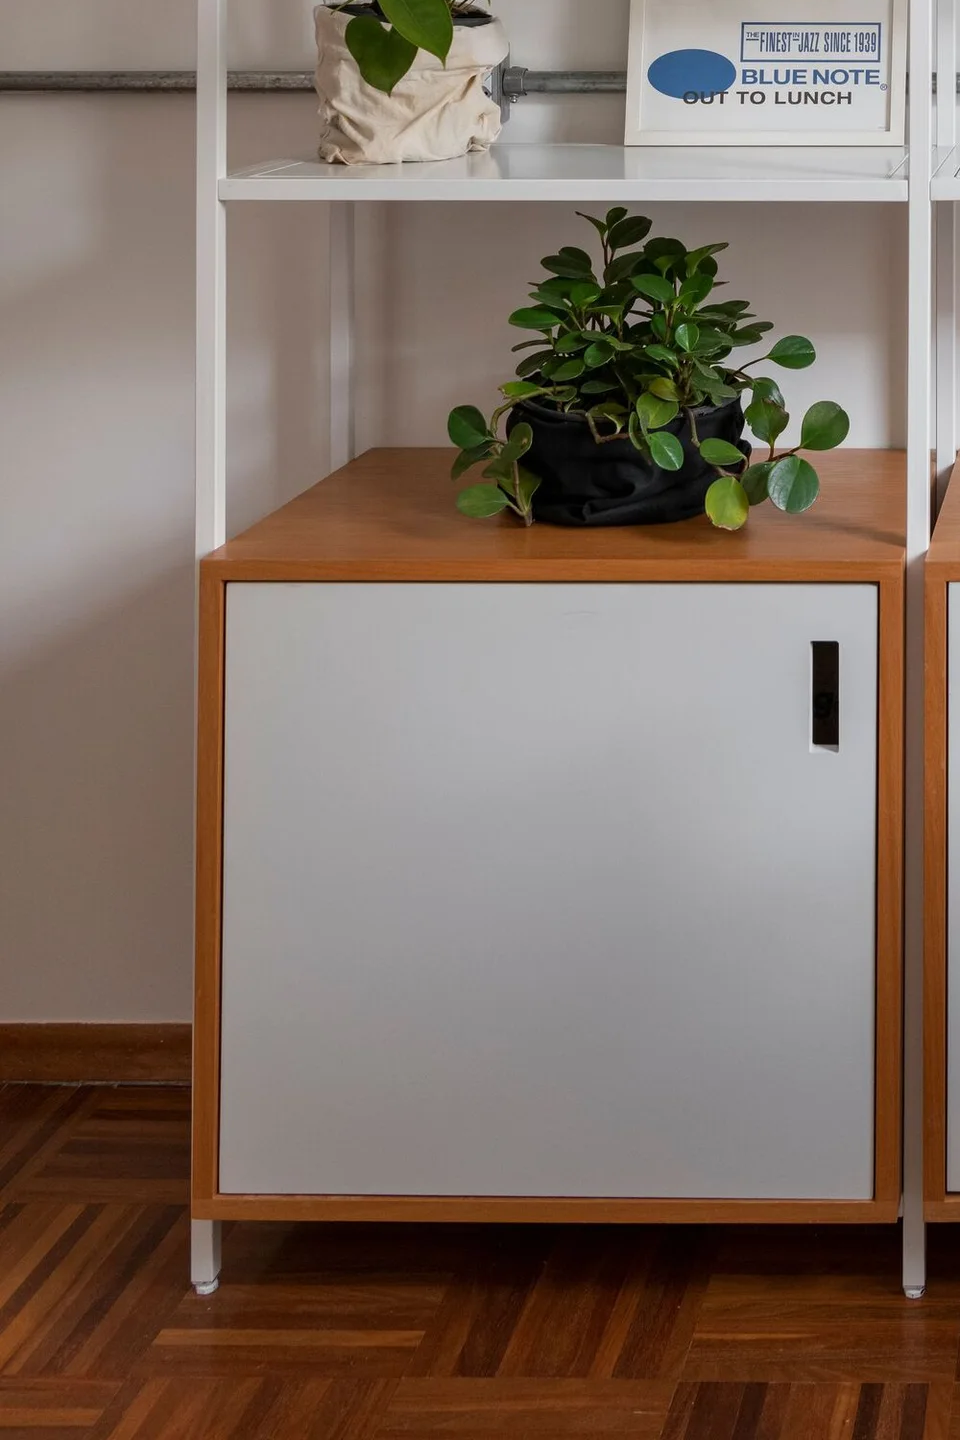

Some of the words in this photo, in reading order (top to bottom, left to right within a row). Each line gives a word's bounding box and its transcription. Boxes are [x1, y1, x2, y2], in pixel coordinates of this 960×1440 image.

[760, 32, 792, 53] FINEST
[798, 32, 820, 53] JAZZ
[823, 32, 851, 53] SINCE
[854, 32, 876, 53] 1939
[741, 69, 808, 85] BLUE
[812, 69, 880, 85] NOTE
[683, 91, 729, 105] OUT
[736, 91, 766, 105] TO
[774, 91, 852, 105] LUNCH
